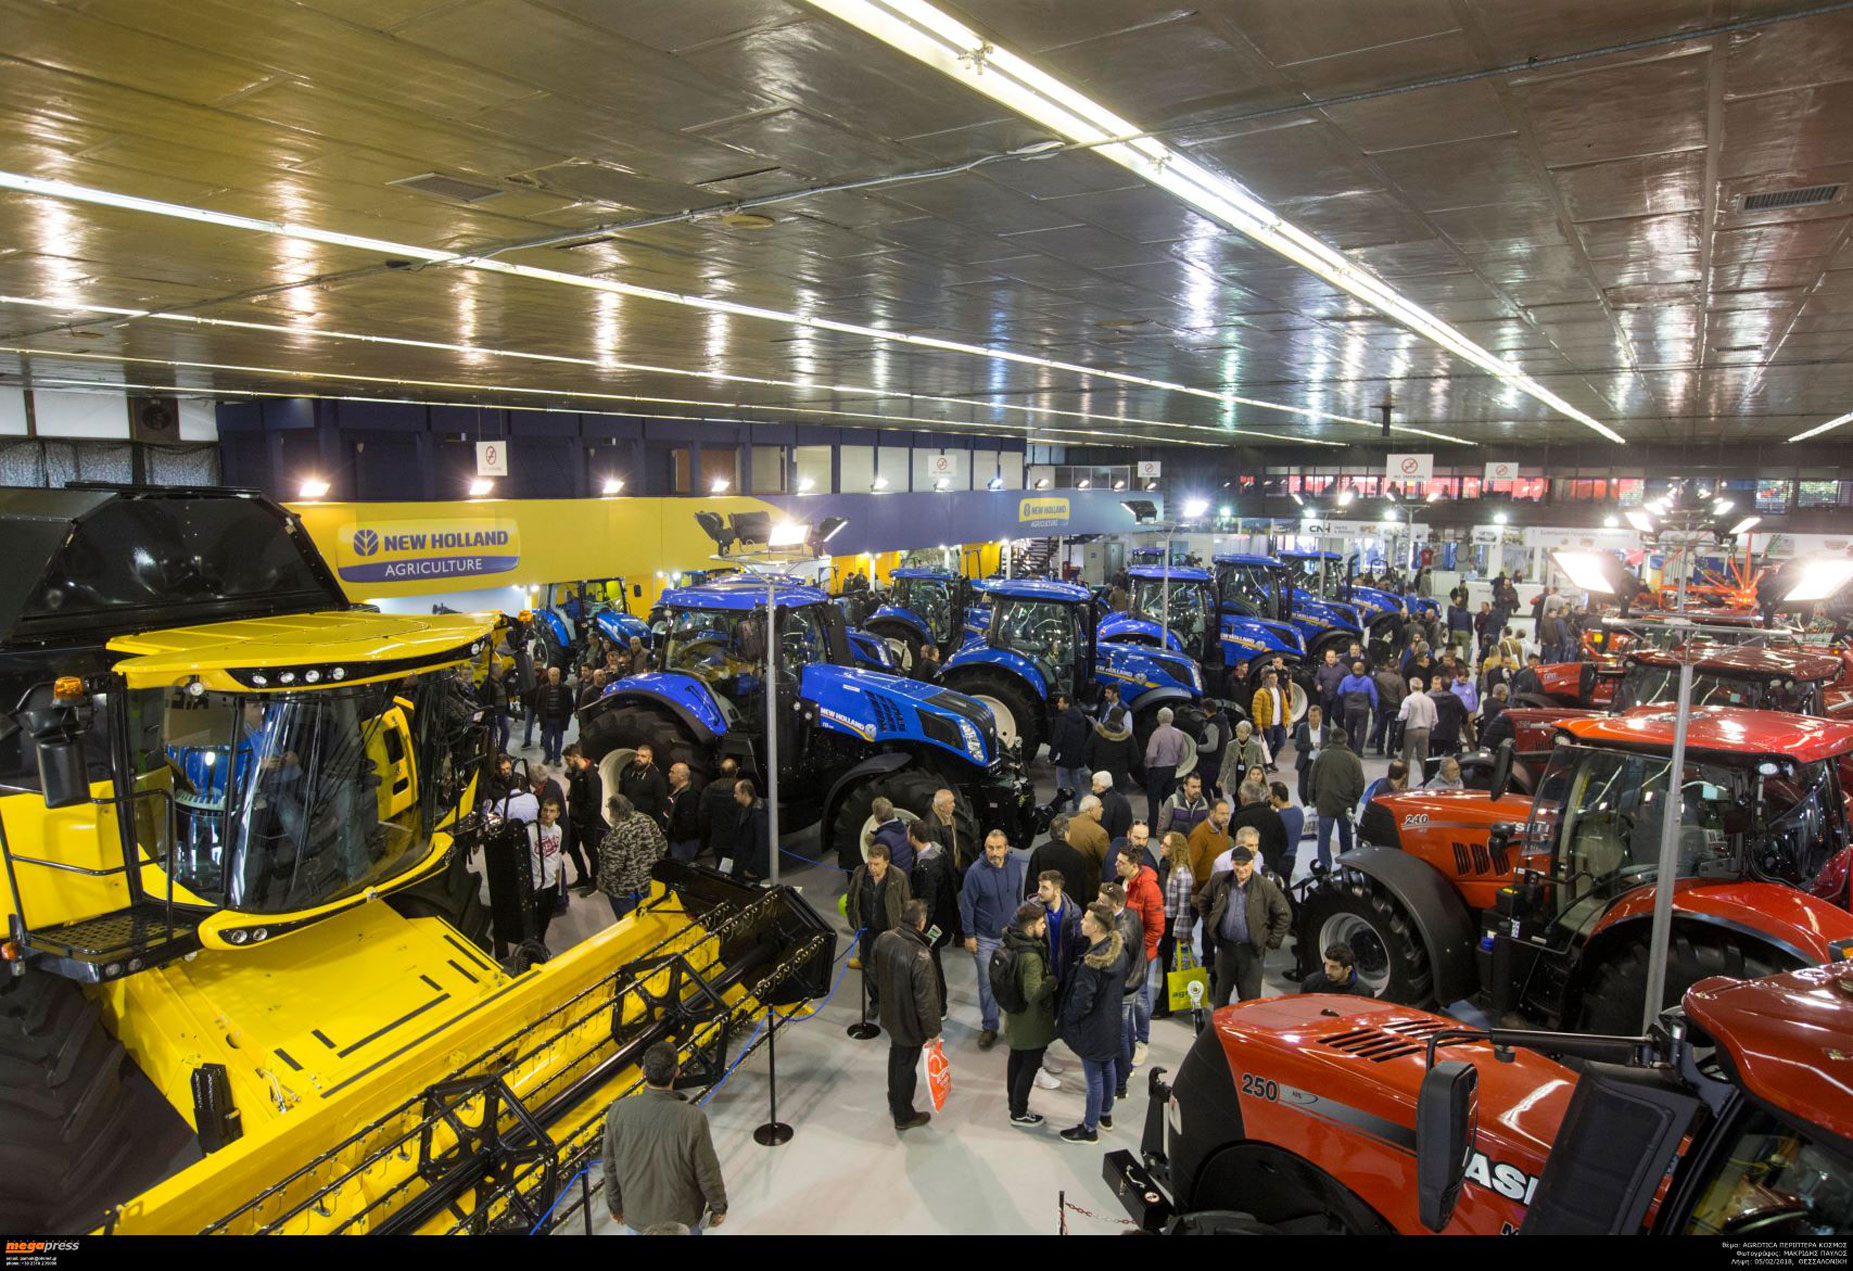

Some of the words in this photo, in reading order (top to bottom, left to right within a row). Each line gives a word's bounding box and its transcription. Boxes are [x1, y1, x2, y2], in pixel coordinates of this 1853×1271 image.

[384, 534, 427, 552] NEW
[431, 531, 509, 549] HOLLAND
[385, 558, 483, 577] AGRICULTURE
[820, 706, 836, 718] NEW
[835, 712, 865, 731] HOLLAND
[1405, 813, 1429, 825] 240
[1242, 1072, 1278, 1102] 250
